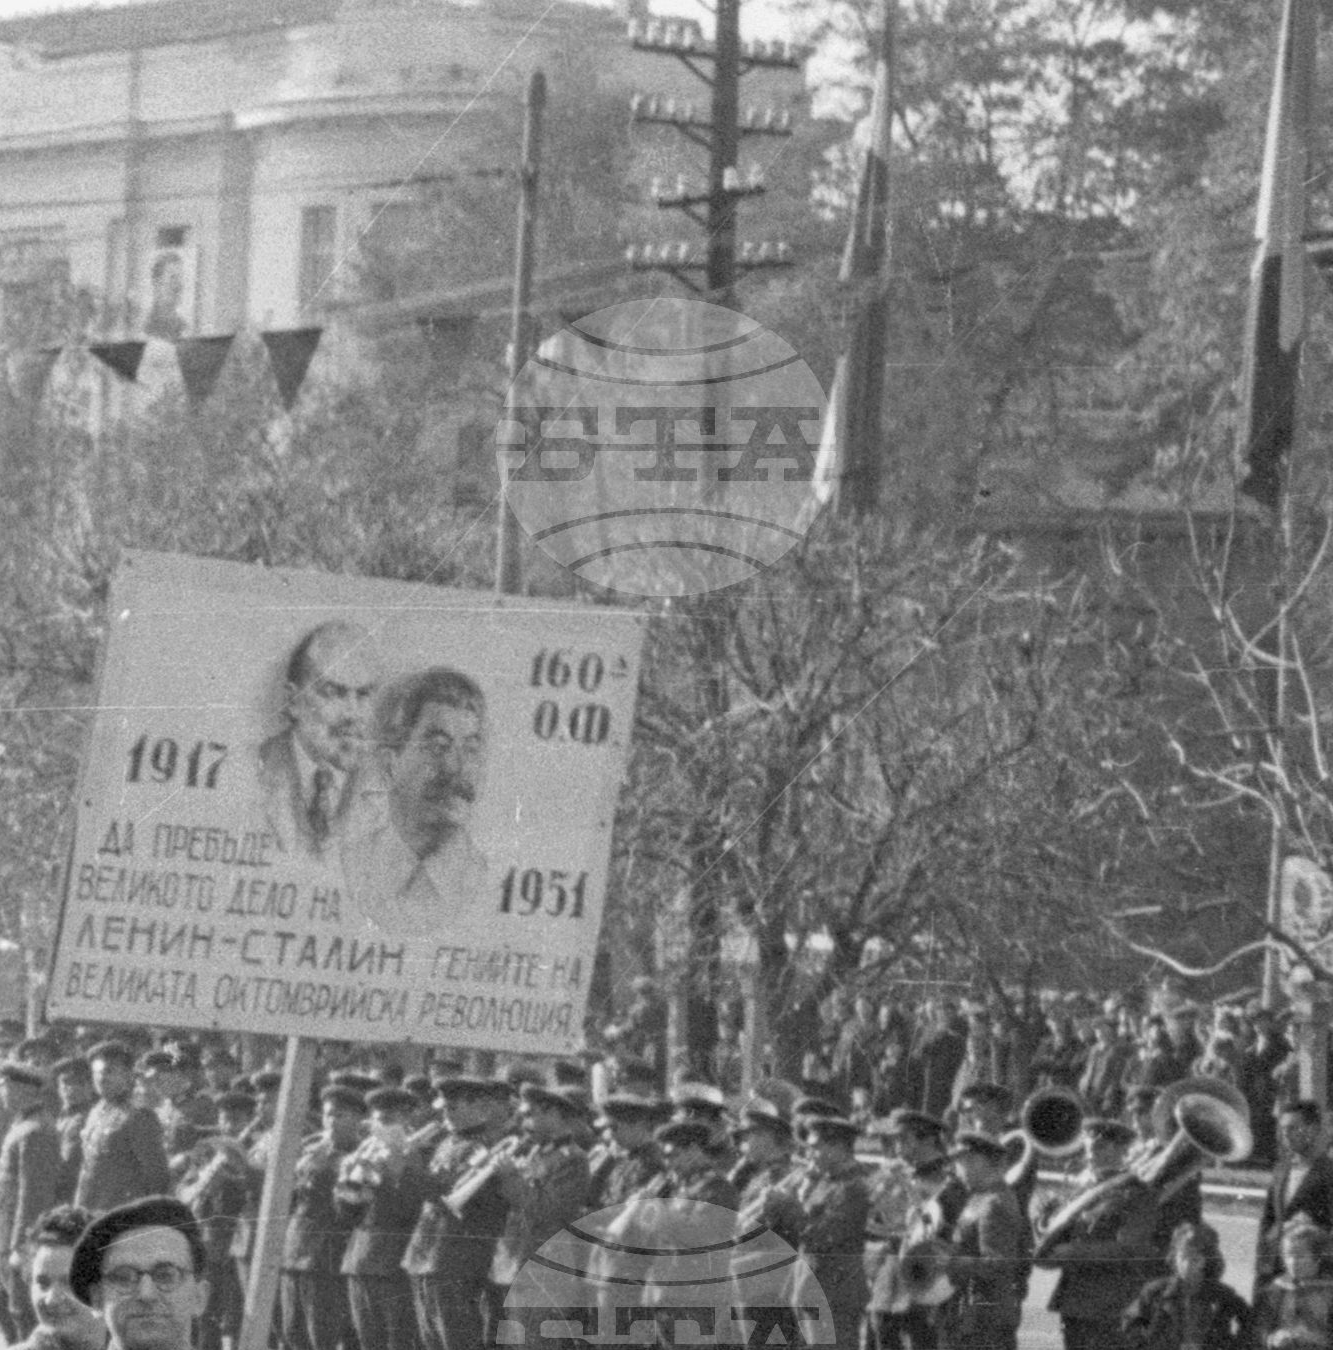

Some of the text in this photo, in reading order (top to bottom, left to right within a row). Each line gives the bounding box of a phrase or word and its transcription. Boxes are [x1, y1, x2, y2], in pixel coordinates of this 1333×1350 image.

[126, 734, 228, 789] 1917
[97, 820, 273, 867] ДА ПРЕБЪДЕ
[78, 864, 341, 922] ВЕЛИКОТО ДЕЛО НА
[498, 866, 587, 919] 1951
[65, 961, 198, 1009] ВЕЛИКАТА
[214, 973, 409, 1024] ОКТОМВРИЙСКА
[551, 956, 582, 990] НА
